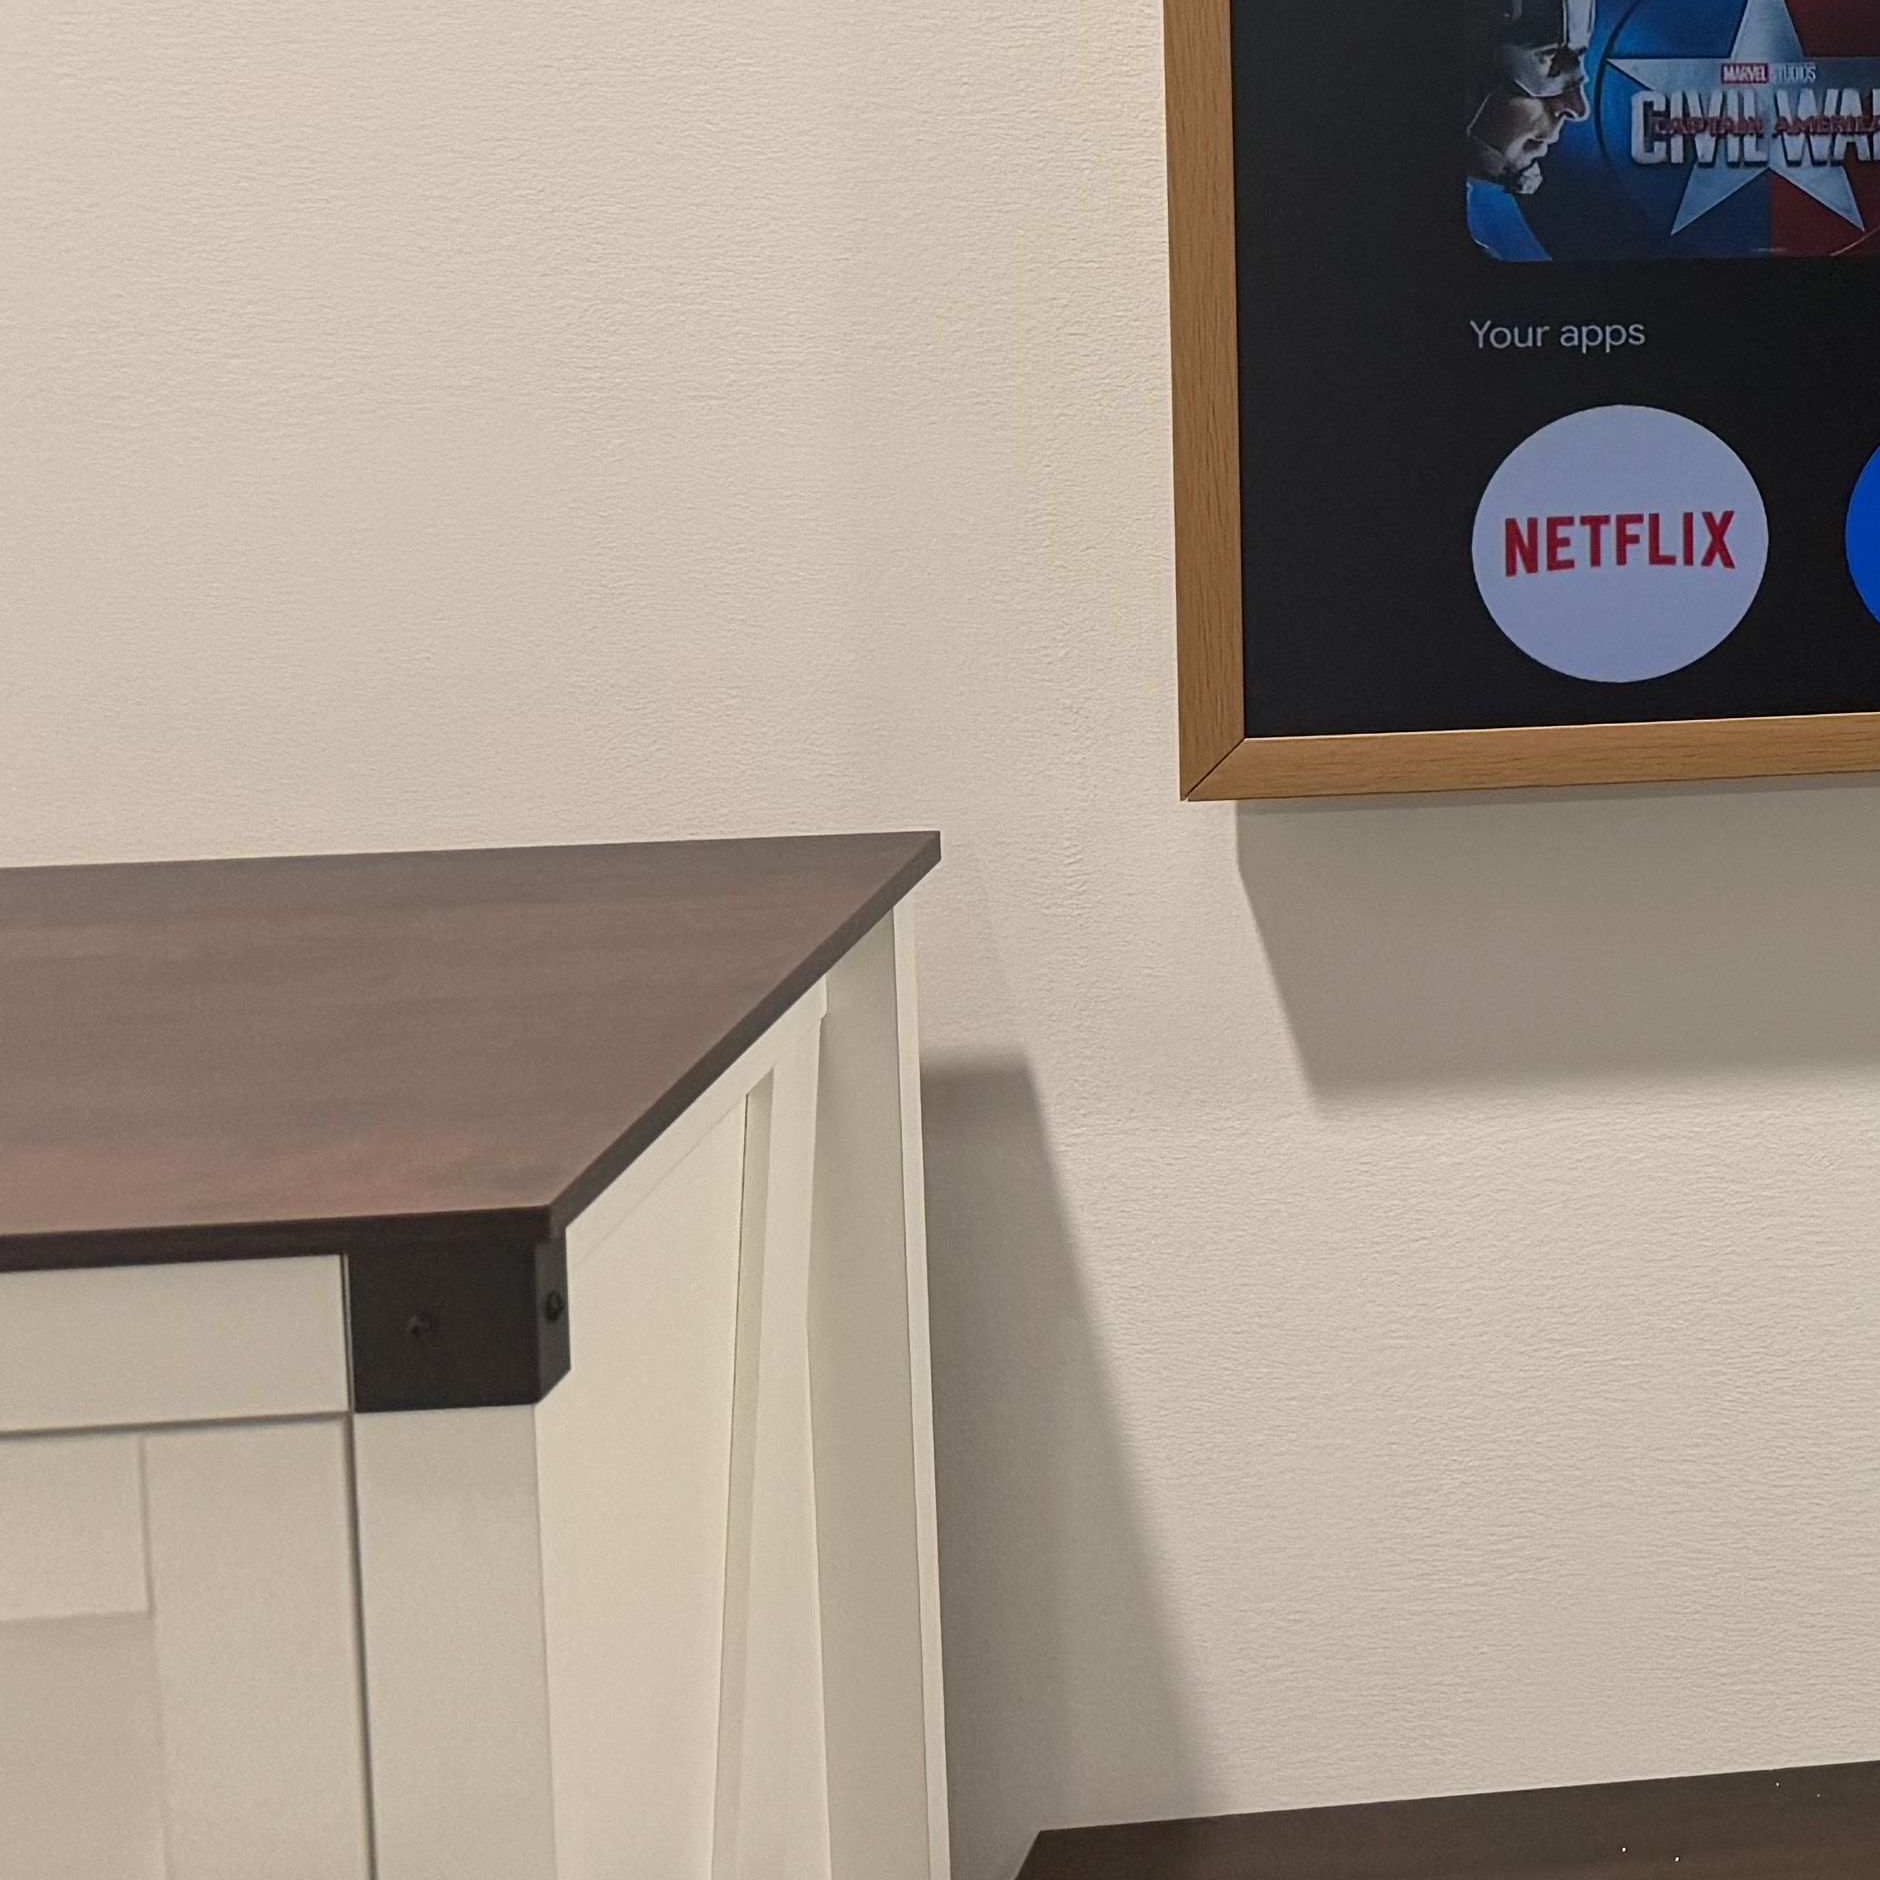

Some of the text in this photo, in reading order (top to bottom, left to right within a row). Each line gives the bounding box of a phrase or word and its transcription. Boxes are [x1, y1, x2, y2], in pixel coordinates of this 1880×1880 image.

[1631, 88, 1768, 166] CIVIL
[1469, 320, 1646, 354] Your apps
[1503, 510, 1736, 576] NETFLIX
